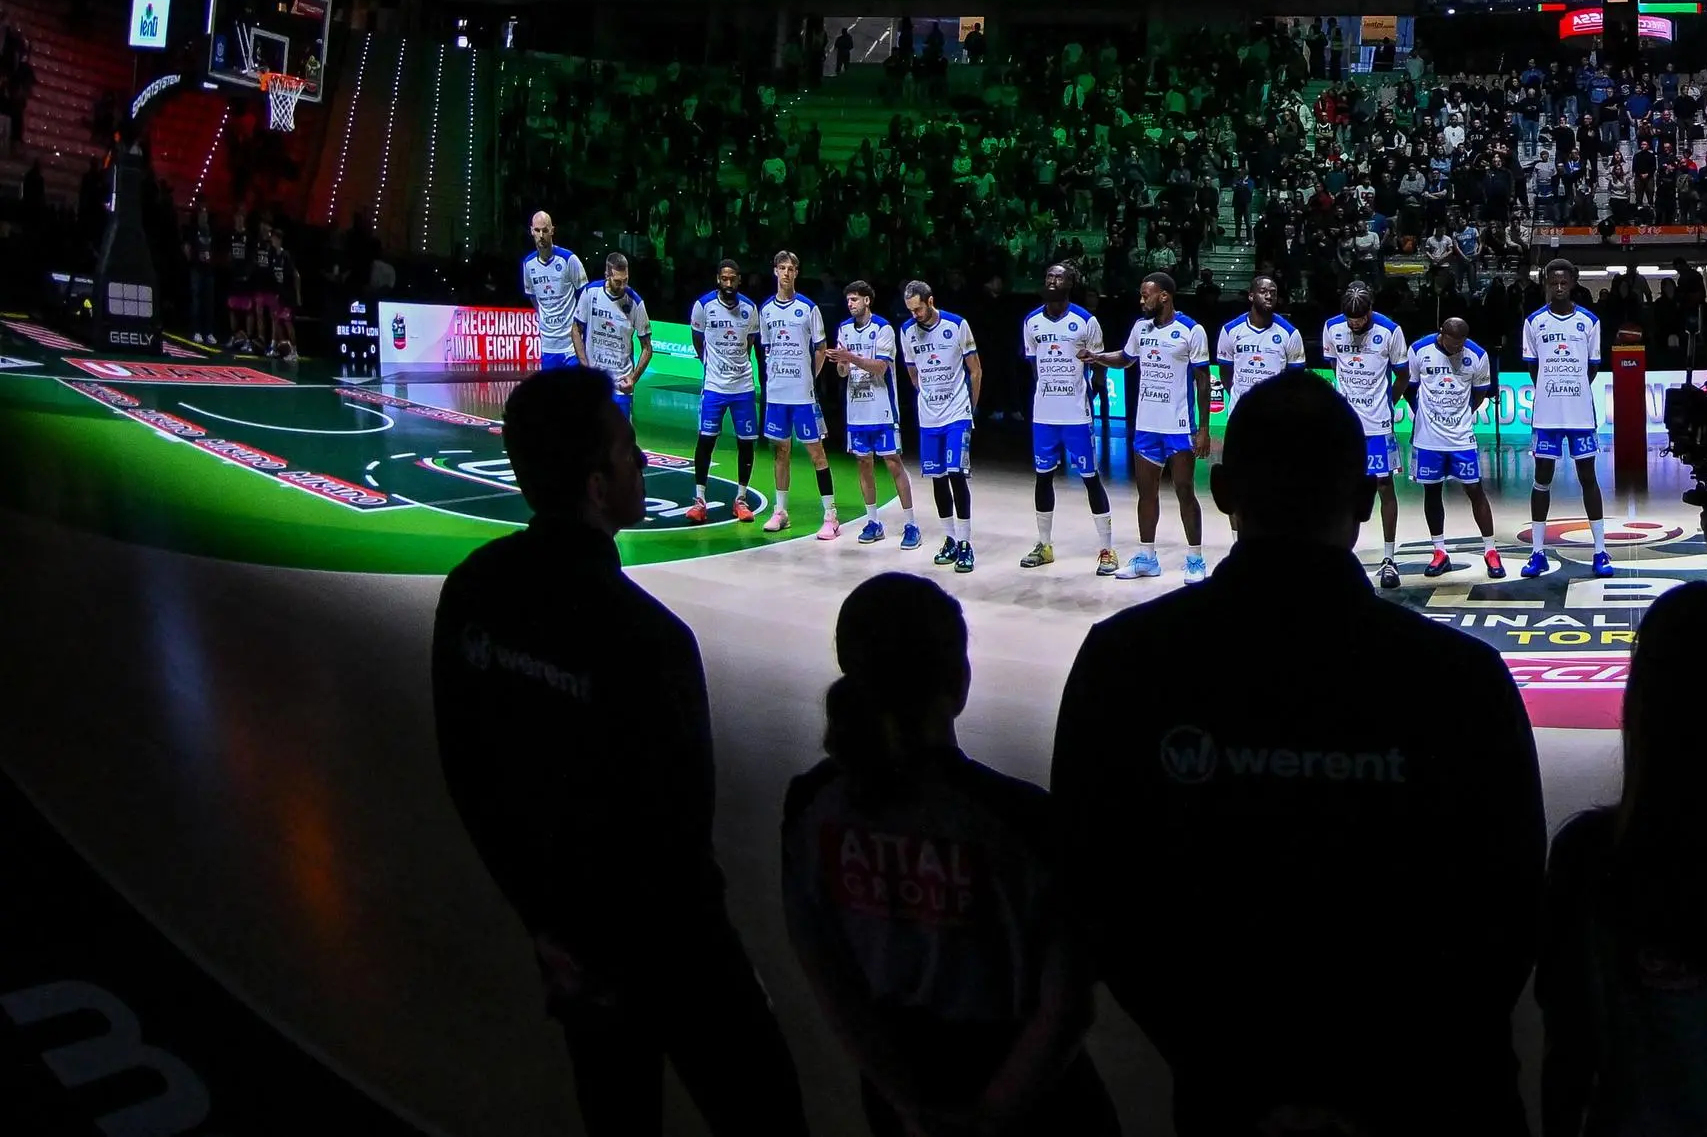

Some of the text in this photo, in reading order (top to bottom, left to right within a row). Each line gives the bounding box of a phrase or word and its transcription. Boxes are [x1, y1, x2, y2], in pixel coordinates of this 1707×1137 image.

[109, 330, 154, 346] GEELY
[486, 338, 521, 360] EIGHT
[802, 423, 810, 436] 6
[1578, 436, 1592, 451] 35
[1078, 455, 1086, 469] 9
[1368, 455, 1384, 469] 23
[1459, 461, 1474, 477] 25
[1226, 745, 1407, 784] werent
[839, 831, 972, 886] ATTAL
[842, 873, 974, 915] GROUP
